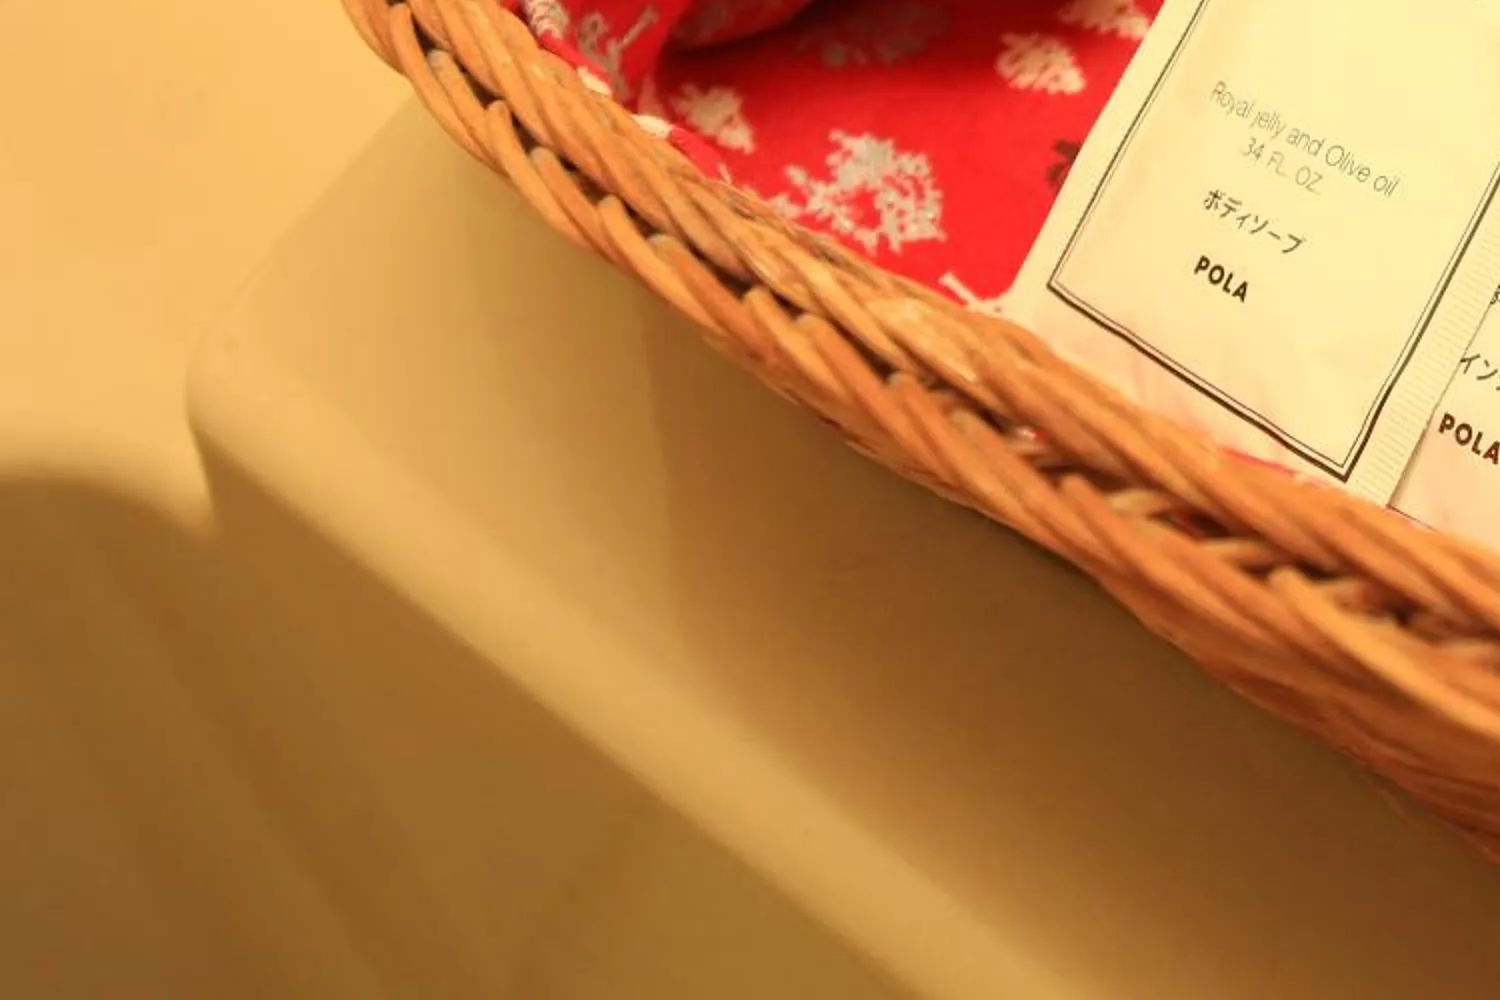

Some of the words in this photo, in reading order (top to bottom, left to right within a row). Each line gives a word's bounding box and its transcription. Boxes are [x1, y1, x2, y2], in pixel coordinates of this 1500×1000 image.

[1210, 80, 1255, 116] Royal
[1248, 110, 1287, 140] jelly
[1286, 127, 1325, 157] and
[1324, 144, 1372, 184] Olive
[1372, 174, 1401, 198] oil
[1203, 188, 1307, 254] ボディソープ
[1193, 255, 1249, 303] POLA
